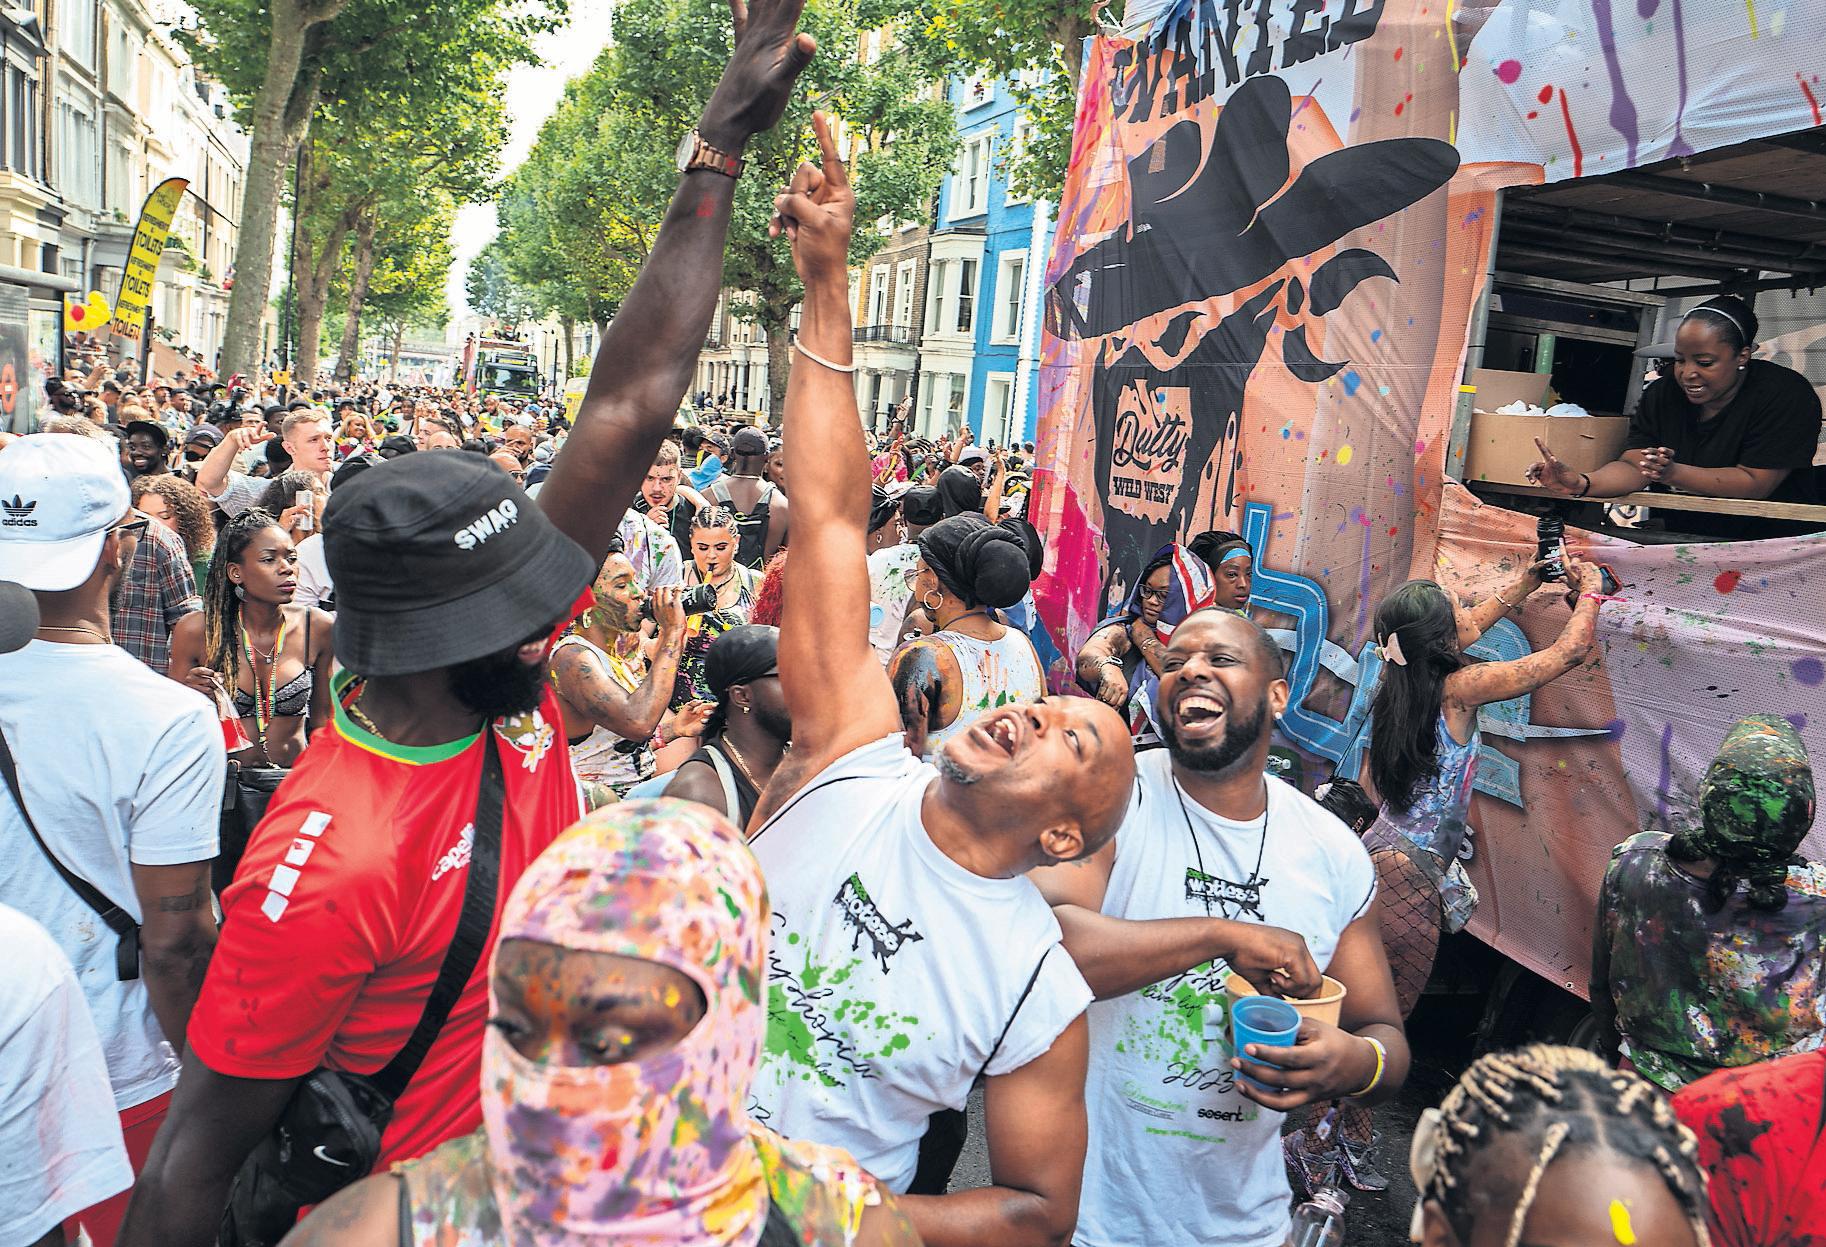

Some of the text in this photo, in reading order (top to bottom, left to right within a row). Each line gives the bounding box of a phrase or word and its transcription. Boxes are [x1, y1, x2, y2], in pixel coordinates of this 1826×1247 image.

[1111, 0, 1386, 123] WANTED
[135, 231, 163, 256] TOILETS
[124, 274, 151, 298] TOILETS
[1113, 411, 1187, 473] Dutty
[1112, 476, 1175, 504] WILD WEST
[2, 518, 38, 526] adidas
[454, 498, 519, 551] SWAG
[1162, 1061, 1236, 1094] 2023
